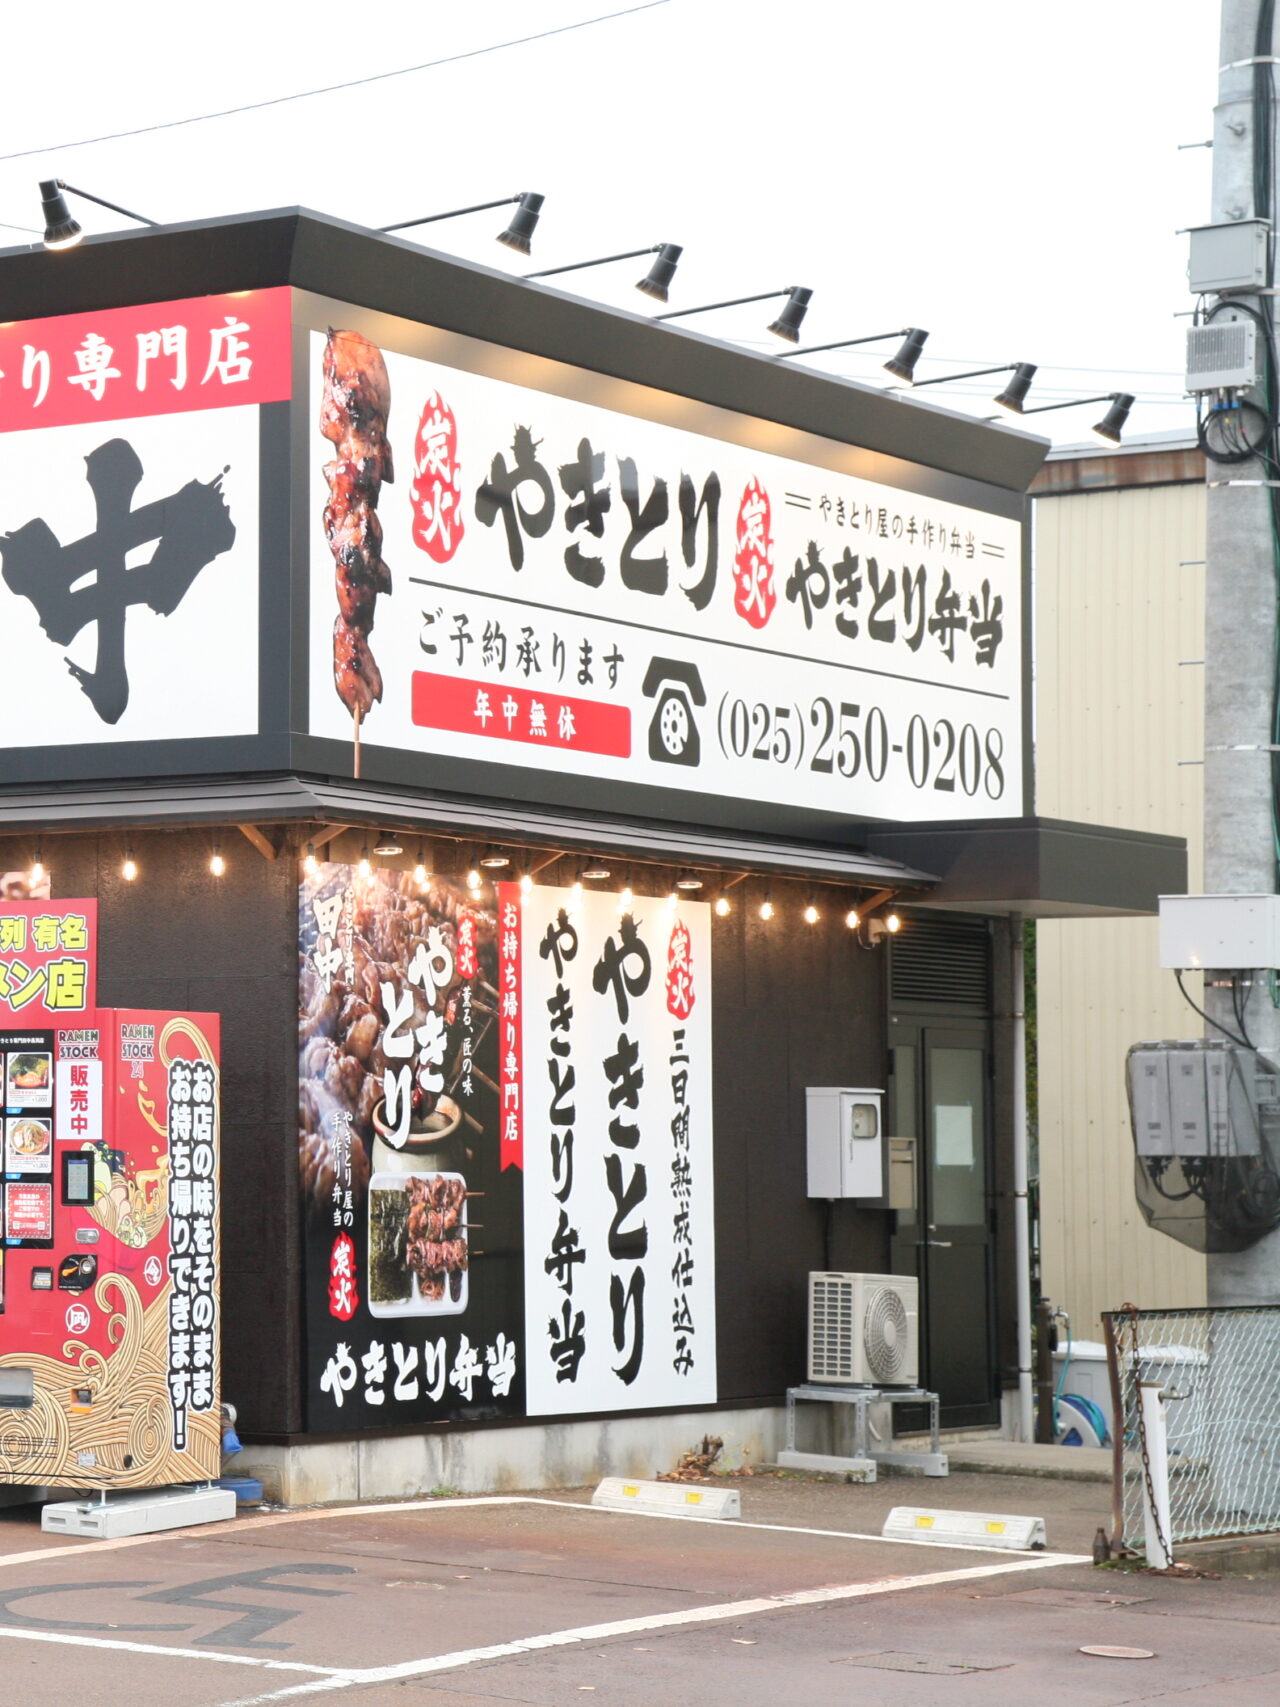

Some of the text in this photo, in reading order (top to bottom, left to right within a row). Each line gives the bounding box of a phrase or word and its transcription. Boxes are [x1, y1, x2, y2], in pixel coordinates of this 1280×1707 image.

[416, 409, 455, 549] 炭火
[475, 422, 721, 612] やきとり
[819, 494, 975, 558] やきとり屋の手作り弁当
[740, 490, 769, 622] 炭火
[784, 538, 1003, 669] やきとり弁当
[420, 607, 624, 690] ご予約承ります
[473, 689, 577, 741] 年中無休
[717, 691, 1005, 801] (025)250-0208
[32, 914, 87, 952] 有名
[669, 931, 691, 1011] 炭火
[58, 1030, 99, 1042] RAMEN
[59, 1046, 99, 1058] STOCK
[121, 1024, 155, 1039] RAMEN
[121, 1044, 154, 1058] STOCK
[502, 902, 519, 1142] お持ち帰り専門店
[70, 1065, 89, 1135] 販売中
[538, 907, 587, 1384] やきとり弁当
[591, 911, 652, 1387] やきとり
[331, 1111, 343, 1228] 手作り弁当
[342, 1111, 354, 1228] やきとり屋の
[669, 1028, 695, 1378] 三日間熟成仕込み
[170, 1065, 193, 1446] お持ち帰りできます!
[191, 1065, 214, 1404] お店の味をそのまま
[333, 1239, 352, 1315] 炭火
[319, 1332, 517, 1408] やきとり弁当
